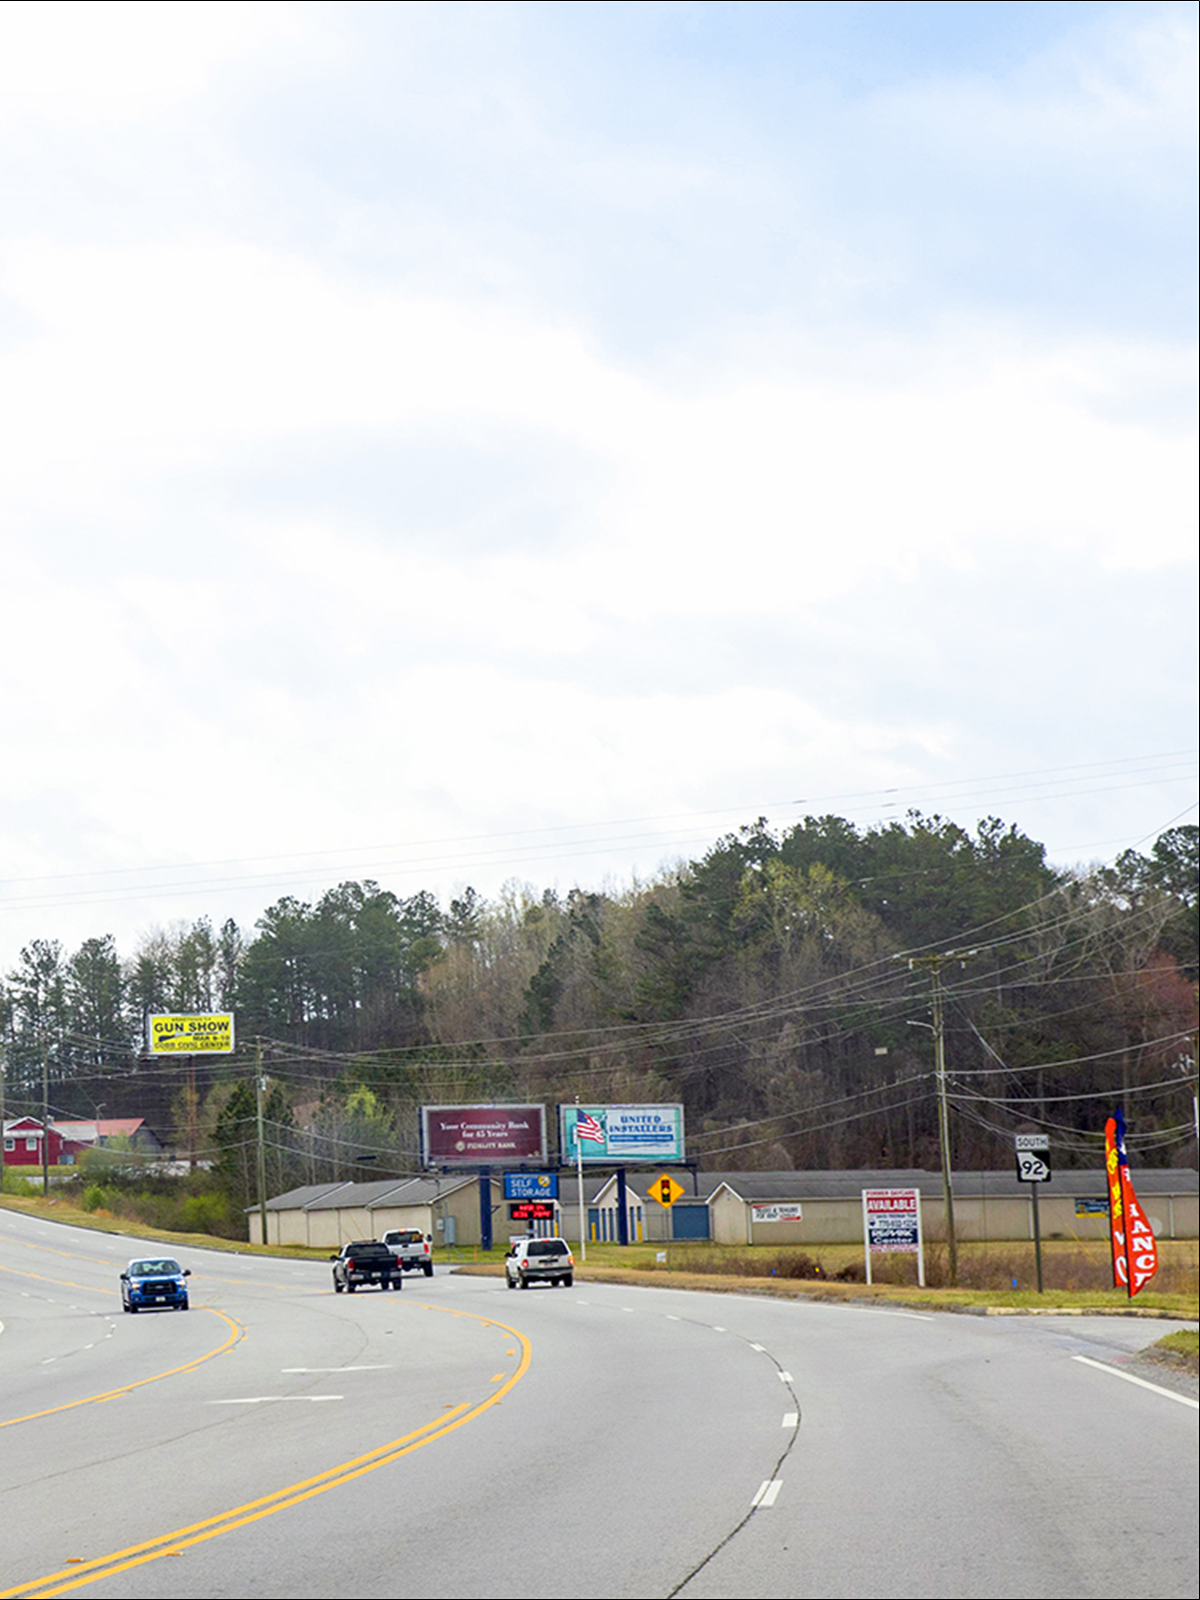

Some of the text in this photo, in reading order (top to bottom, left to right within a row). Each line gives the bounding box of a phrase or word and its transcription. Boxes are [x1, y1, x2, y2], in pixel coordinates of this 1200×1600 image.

[154, 1021, 229, 1033] GUN SHOW
[440, 1121, 529, 1131] Your Community Bank
[609, 1125, 673, 1133] INSTALLERS
[1017, 1137, 1047, 1147] SOUTH
[1022, 1161, 1043, 1175] 92
[511, 1179, 531, 1187] SELF
[511, 1188, 551, 1197] STORAGE
[867, 1199, 916, 1210] AVAILABLE
